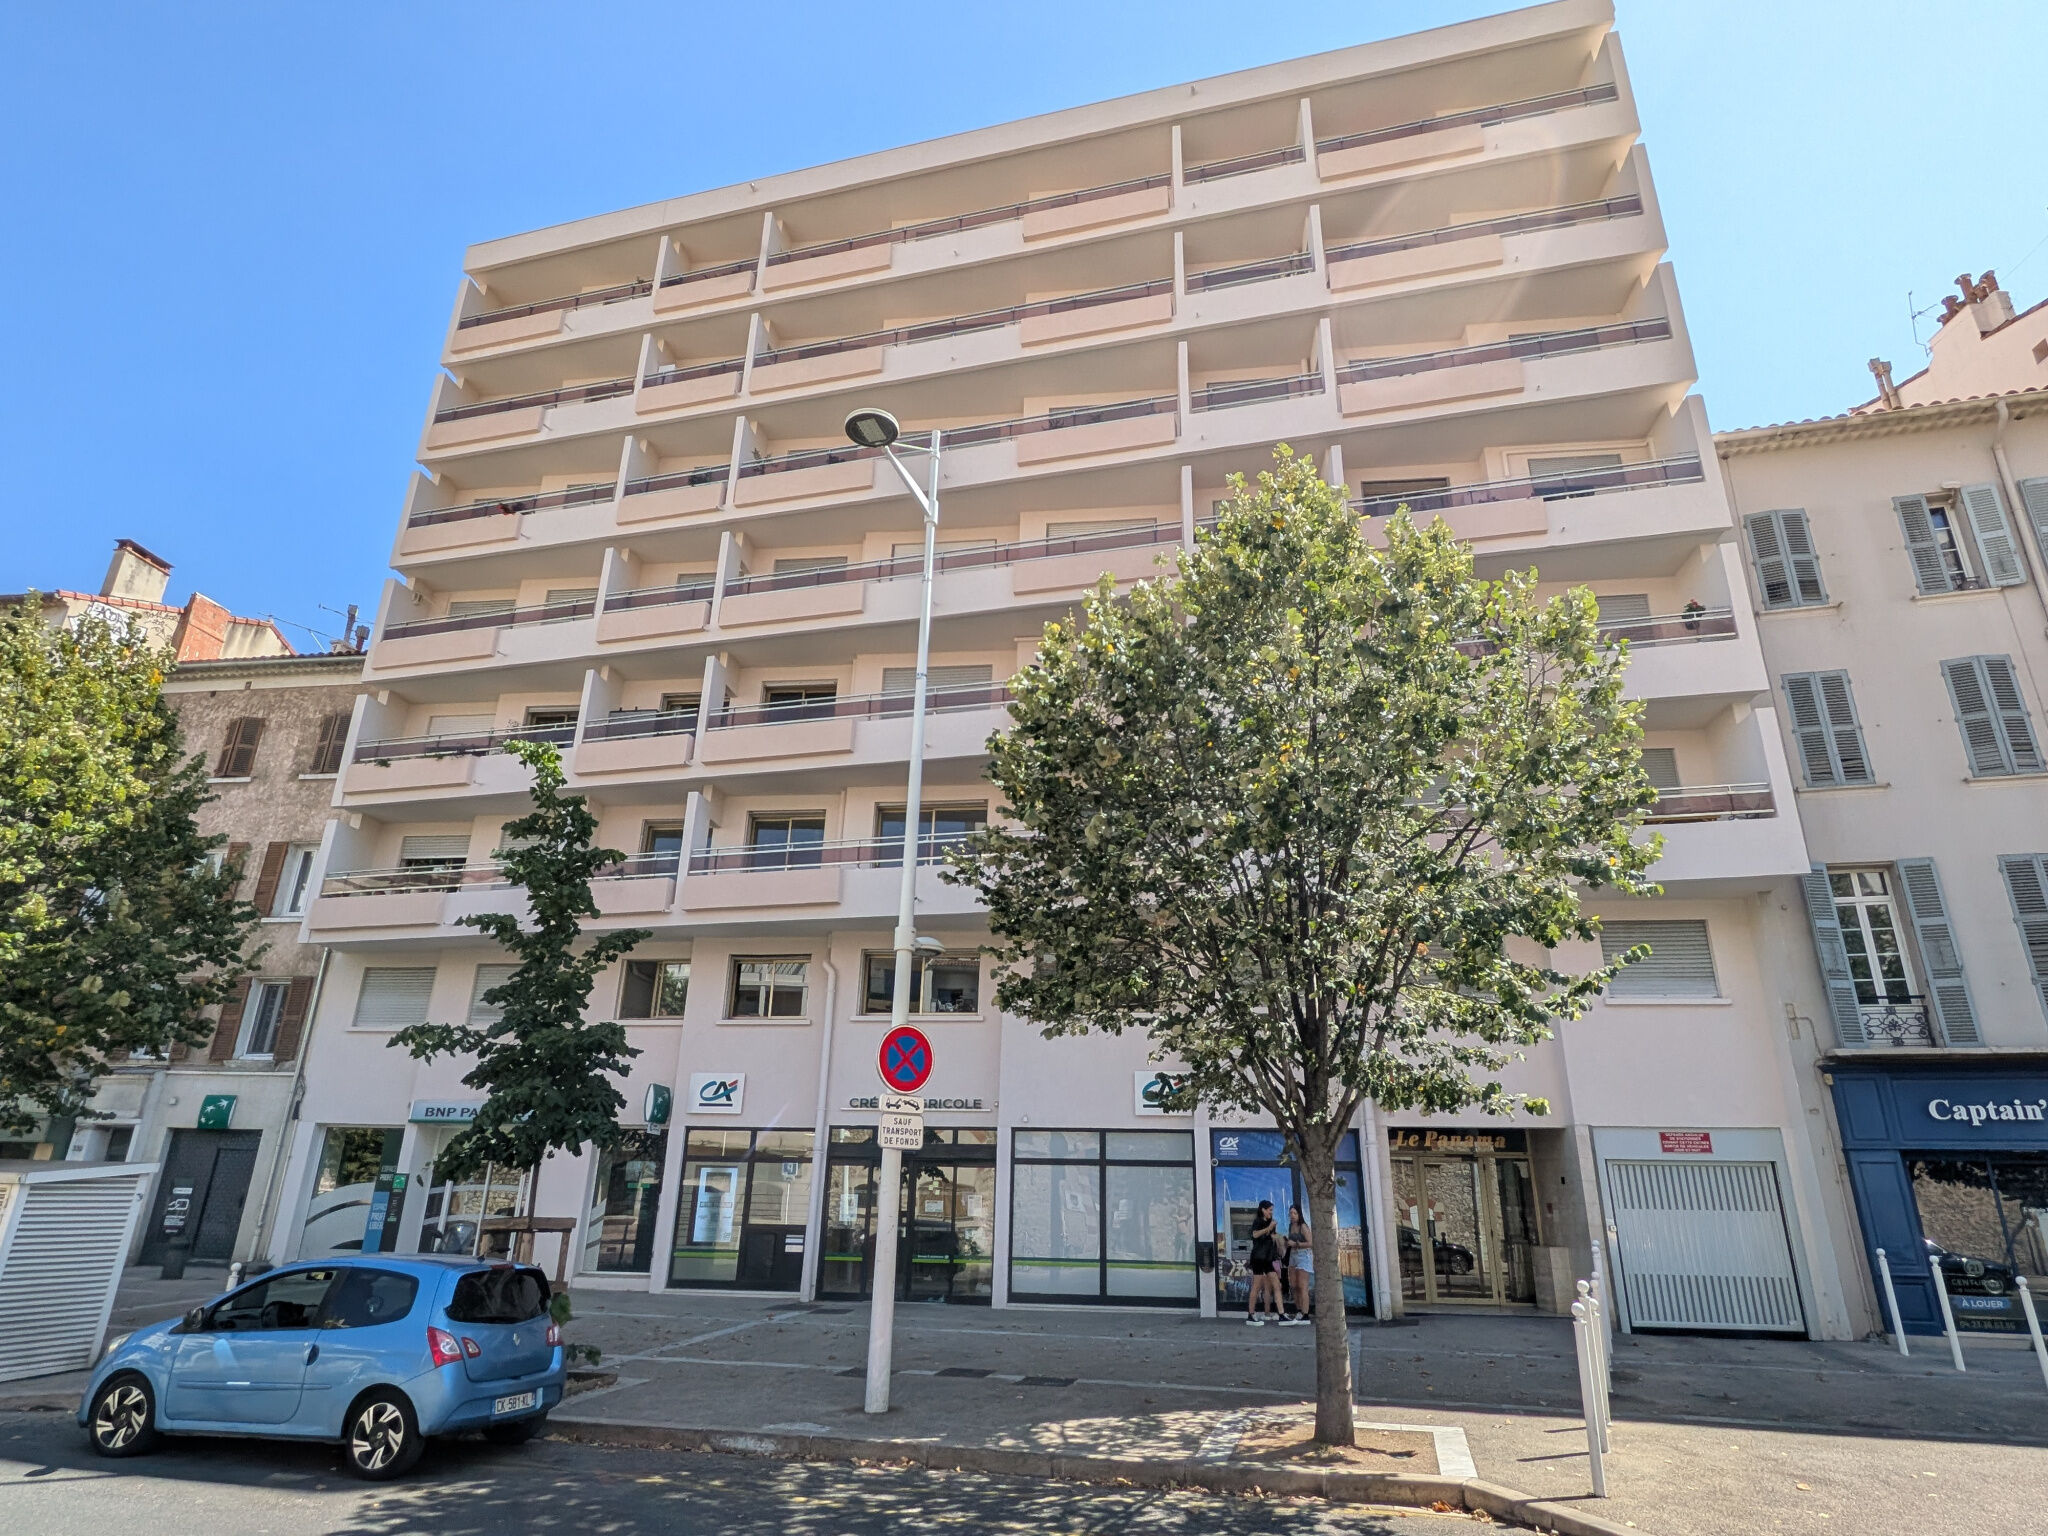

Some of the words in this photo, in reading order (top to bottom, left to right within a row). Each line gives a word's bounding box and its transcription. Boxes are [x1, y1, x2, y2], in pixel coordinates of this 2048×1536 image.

[700, 1080, 738, 1101] CA
[424, 1107, 456, 1117] BNP
[1928, 1098, 2047, 1126] Captain'
[893, 1117, 912, 1126] SAUF
[882, 1126, 922, 1137] TRANSPORT
[884, 1137, 894, 1145] DE
[895, 1138, 919, 1147] FONDS
[1396, 1130, 1420, 1147] Le
[1424, 1130, 1506, 1149] Panama
[1962, 1296, 1970, 1307] À
[1971, 1299, 2004, 1308] LOUER
